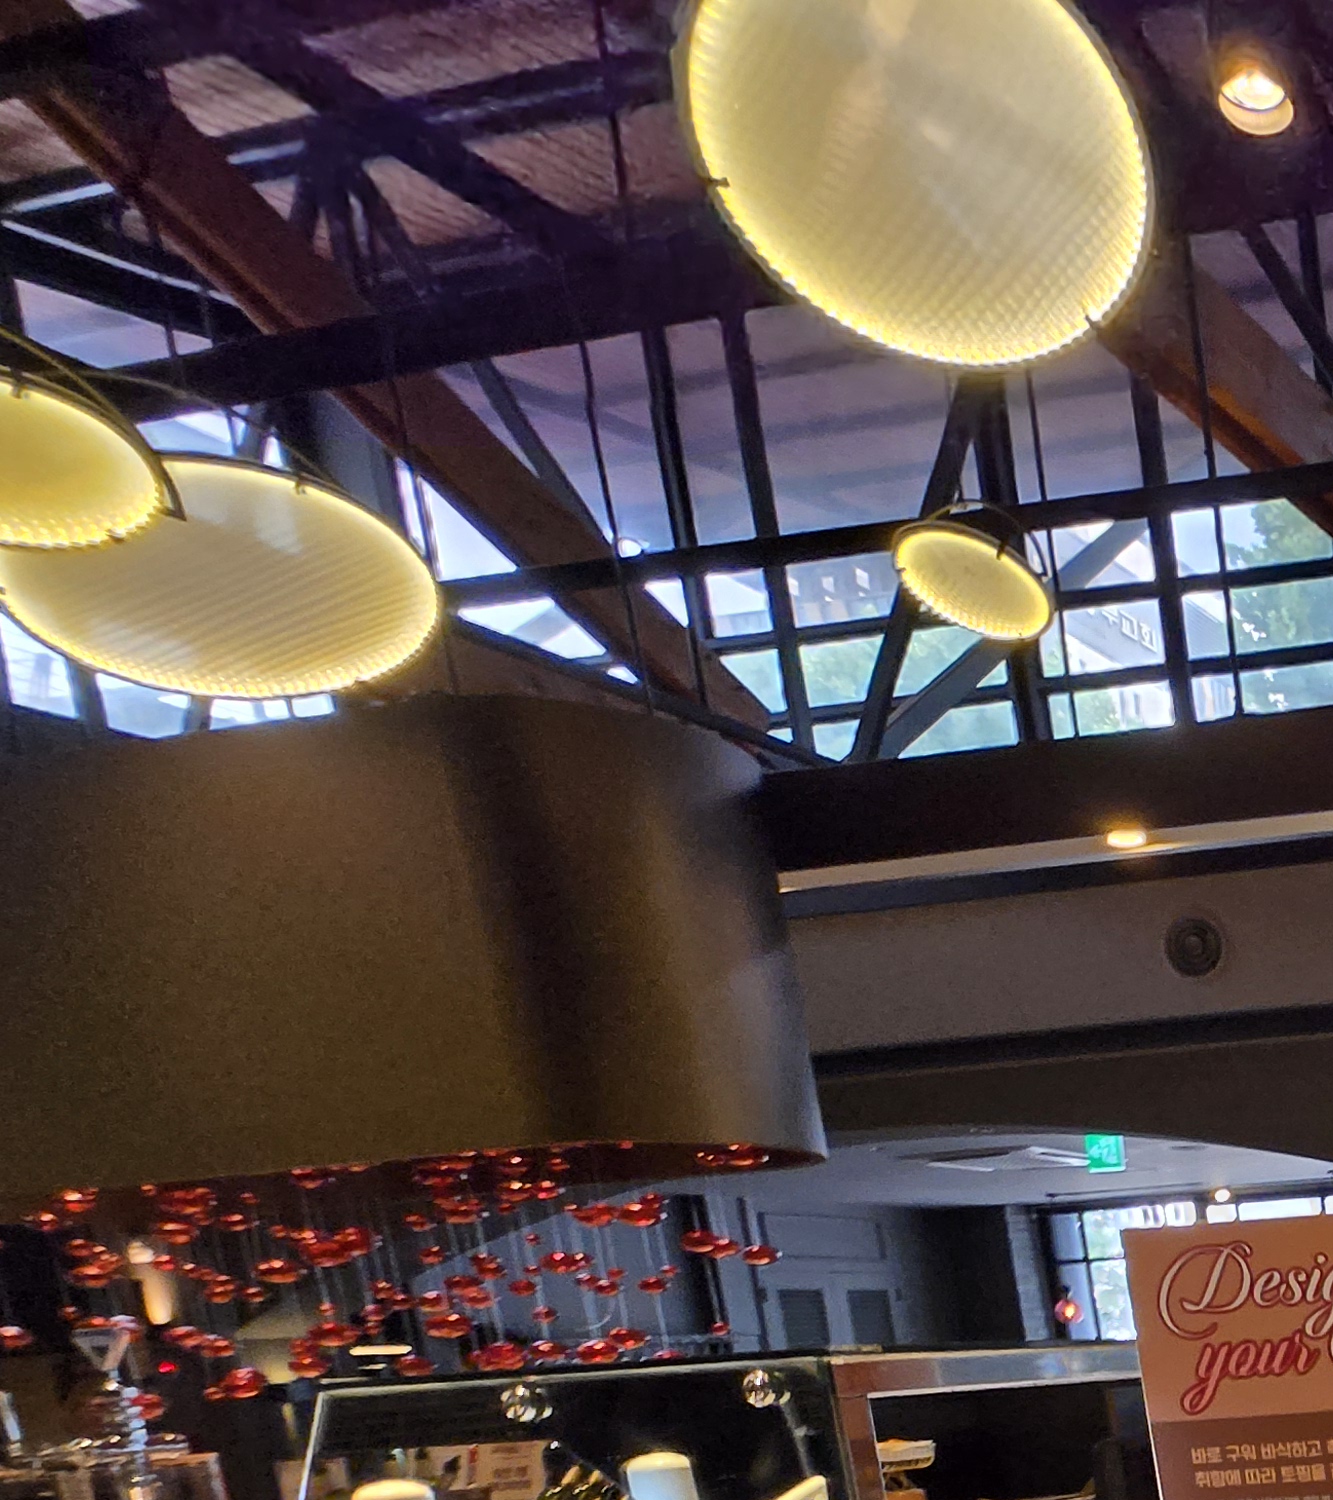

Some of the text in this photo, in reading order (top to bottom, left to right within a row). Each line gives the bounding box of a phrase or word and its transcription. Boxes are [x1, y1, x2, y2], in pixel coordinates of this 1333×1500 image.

[1180, 1326, 1320, 1415] your
[1192, 1447, 1222, 1464] 바로
[1226, 1444, 1257, 1461] 구워
[1195, 1469, 1242, 1488] 취향에
[1245, 1467, 1276, 1485] 따라
[1281, 1463, 1326, 1483] 토핑을
